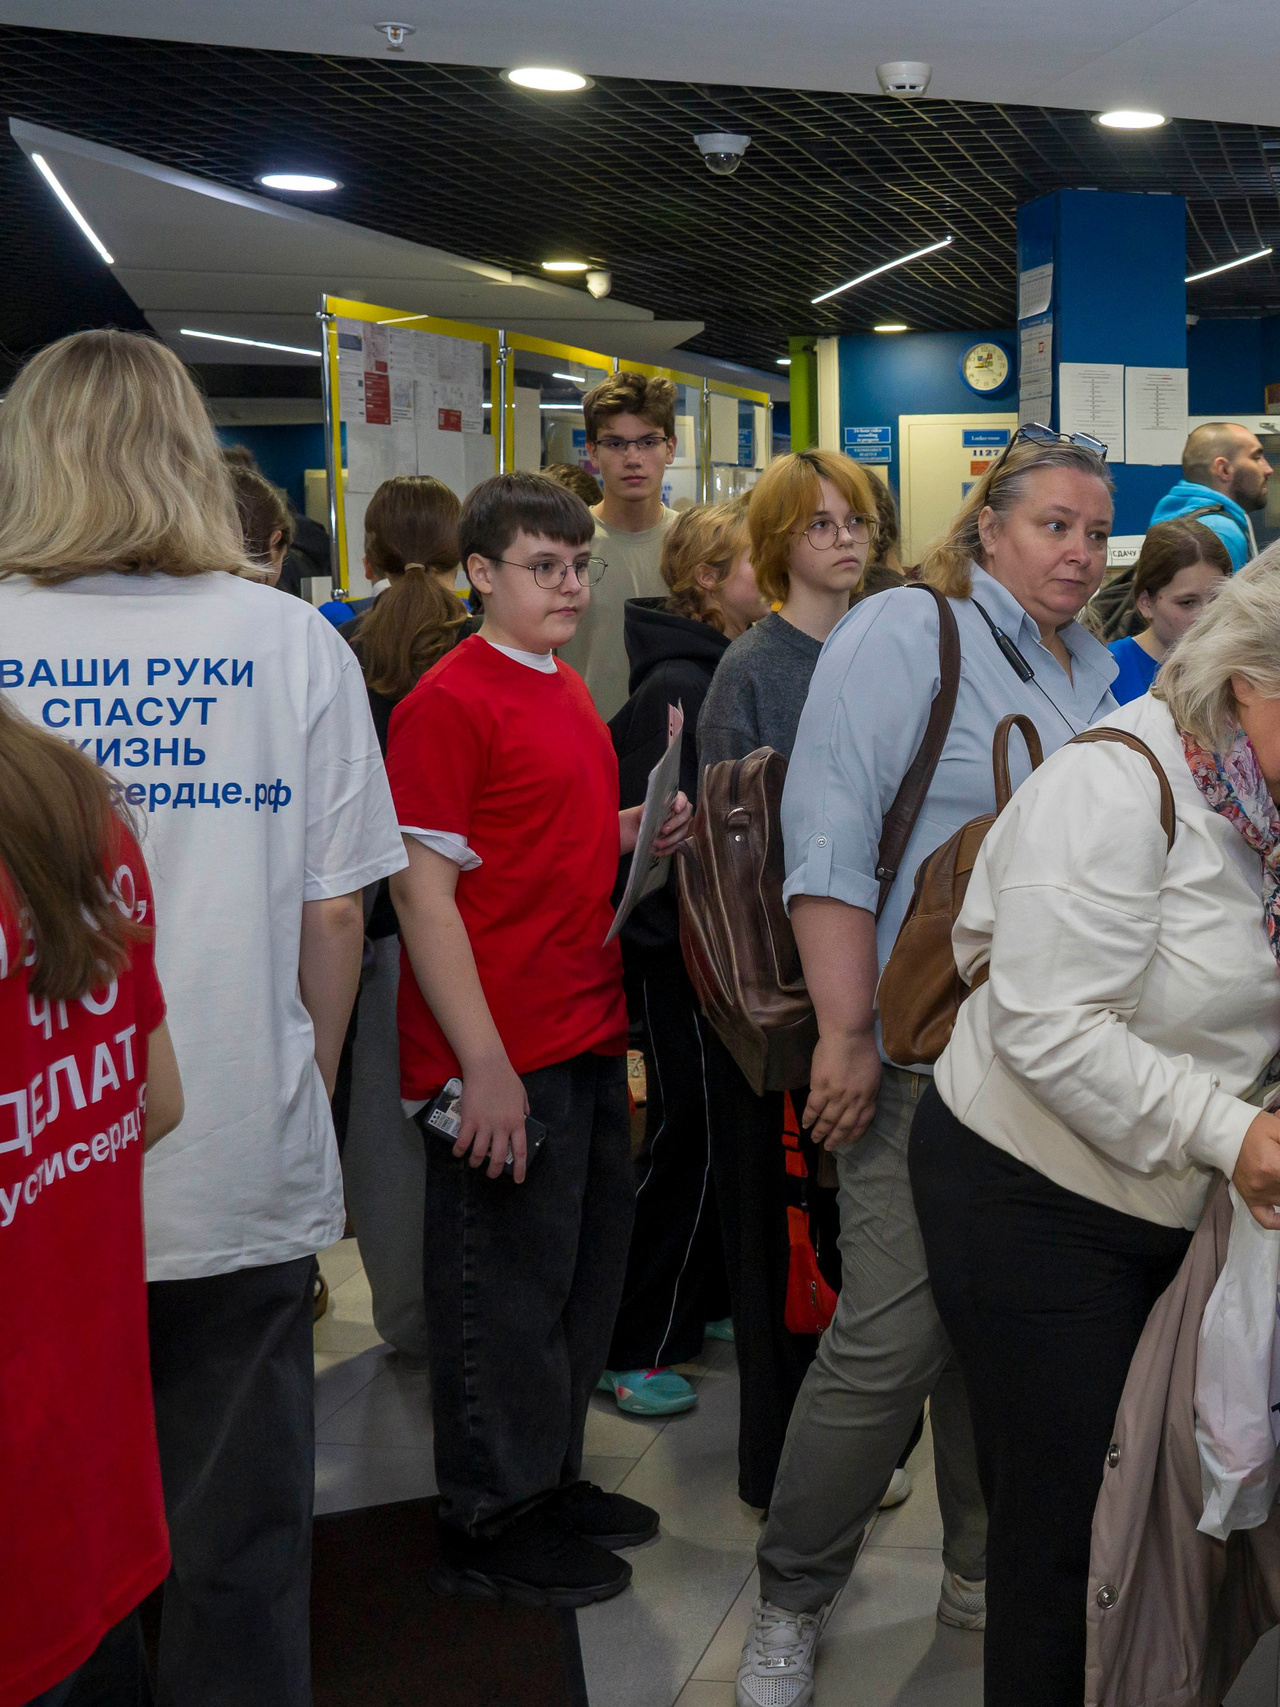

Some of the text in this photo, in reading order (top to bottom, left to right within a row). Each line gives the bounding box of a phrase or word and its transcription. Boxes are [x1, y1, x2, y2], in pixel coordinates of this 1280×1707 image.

[0, 658, 254, 688] ВАШИ РУКИ
[42, 697, 217, 728] СПАСУТ
